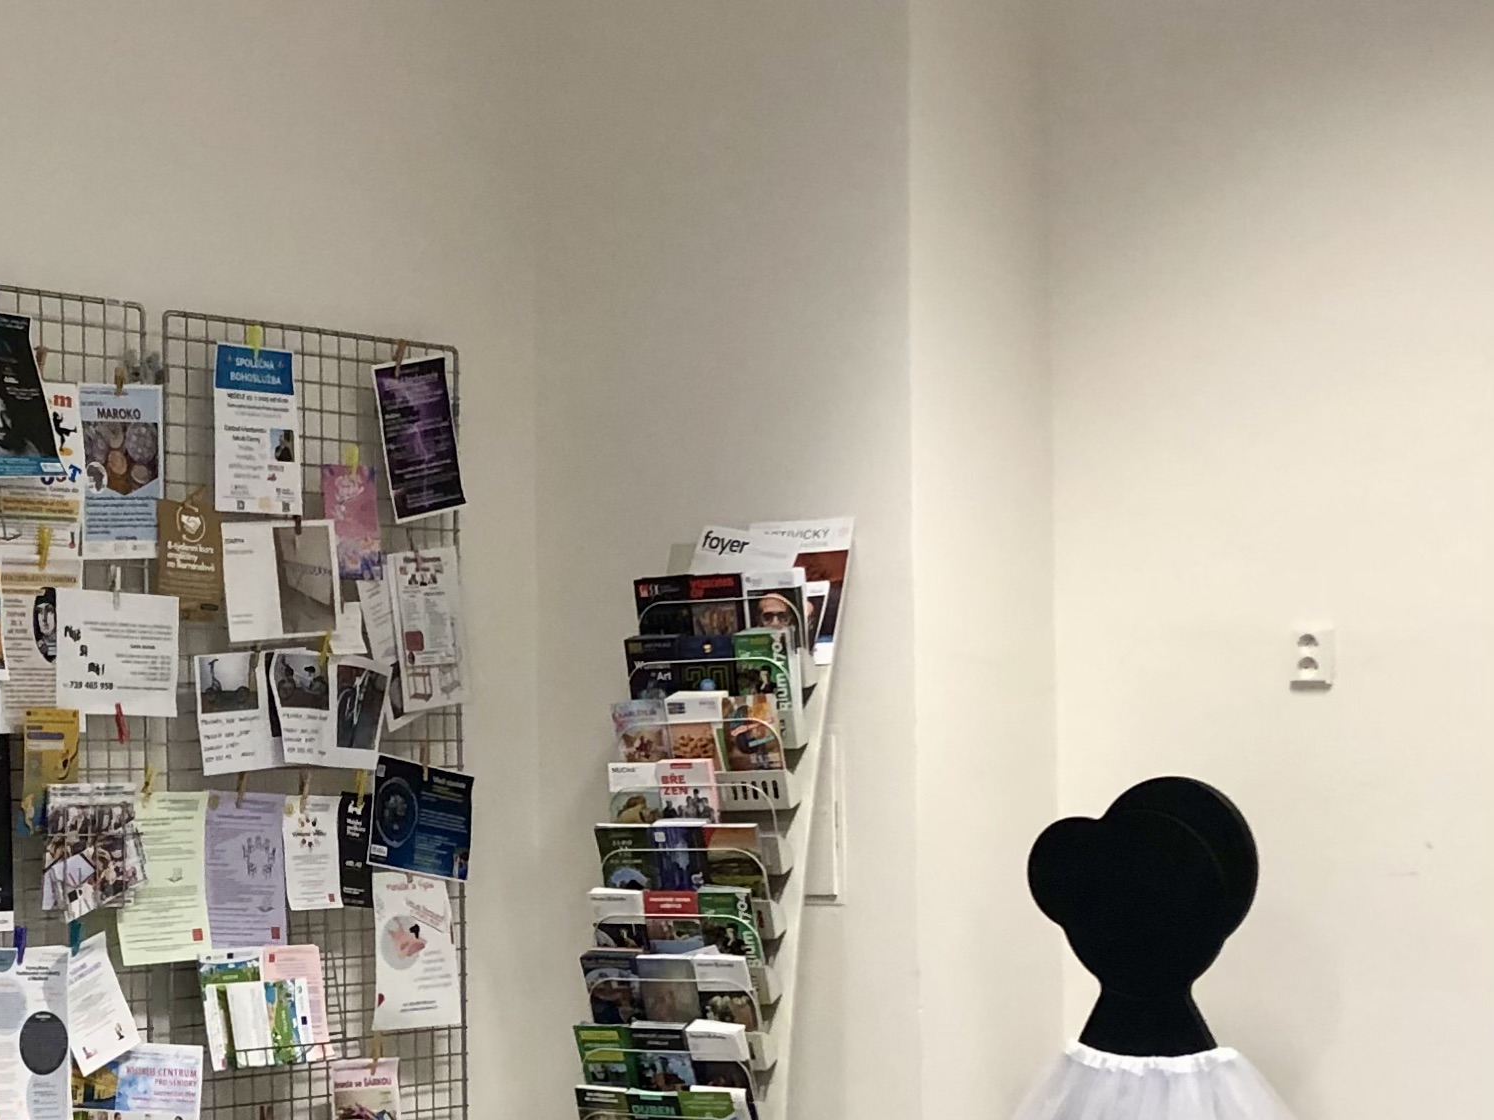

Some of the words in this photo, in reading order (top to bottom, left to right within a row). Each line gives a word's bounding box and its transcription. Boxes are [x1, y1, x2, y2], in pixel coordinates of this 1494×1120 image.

[97, 408, 142, 421] MAROKO
[702, 530, 751, 556] foyer
[157, 1067, 198, 1078] CENTRUM
